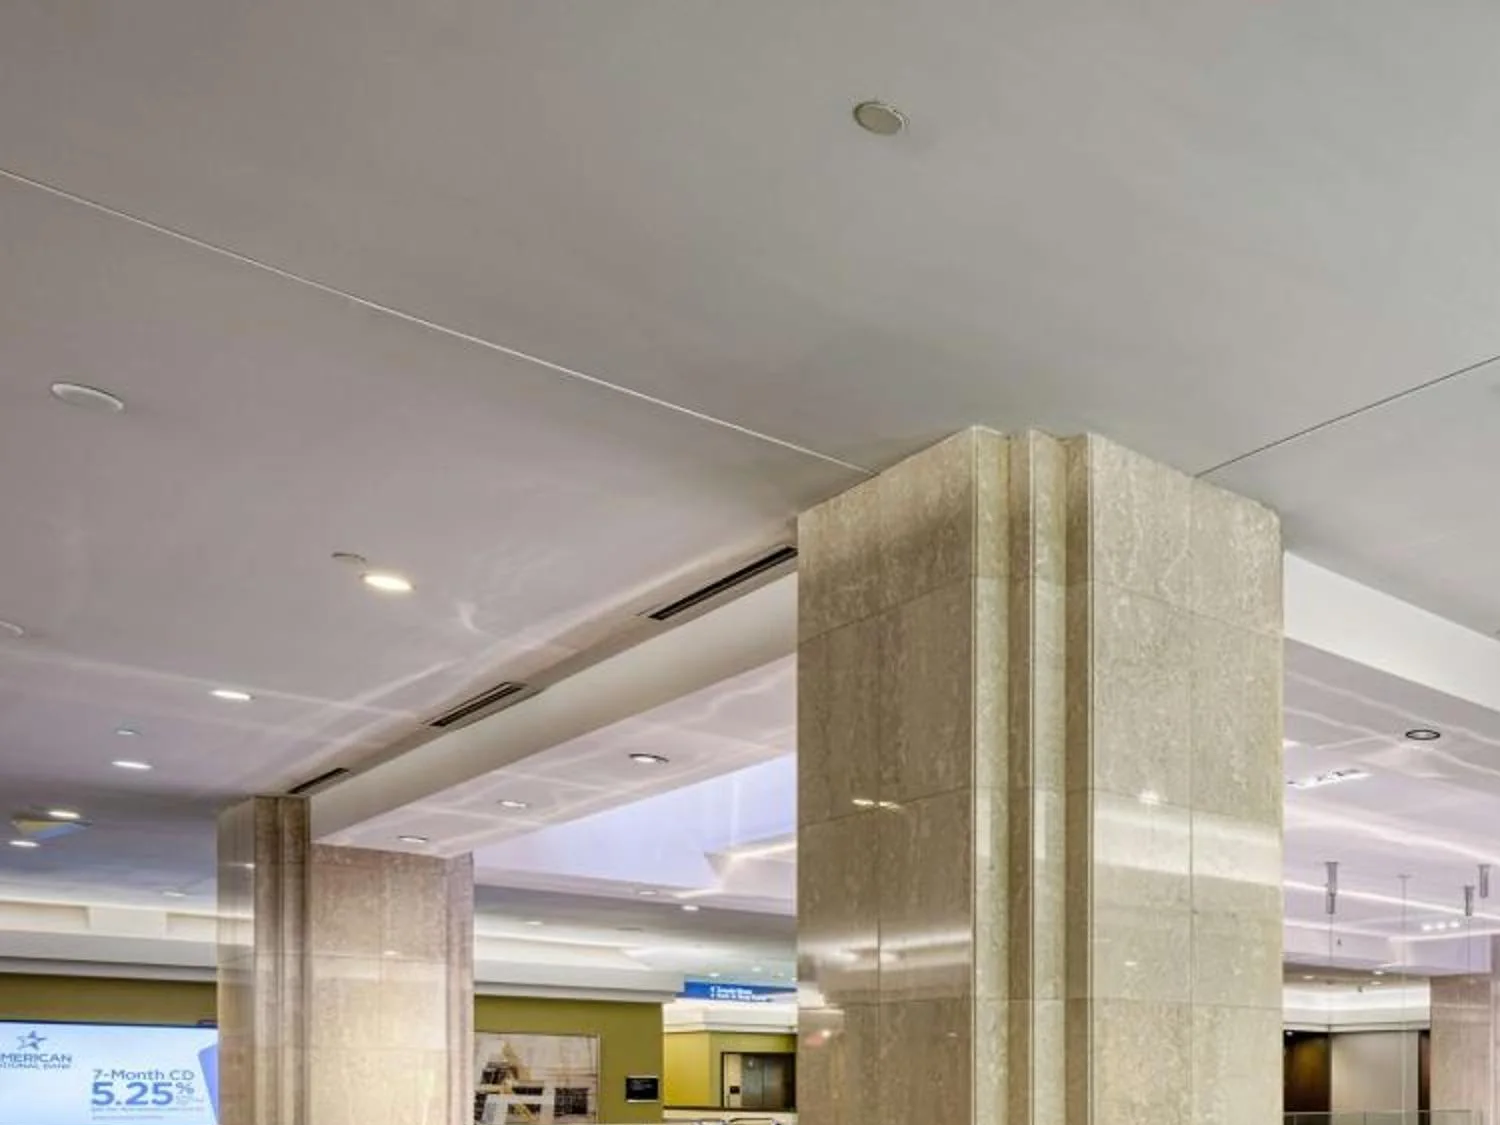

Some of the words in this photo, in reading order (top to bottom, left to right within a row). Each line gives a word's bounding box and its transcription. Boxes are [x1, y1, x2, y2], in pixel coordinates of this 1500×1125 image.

[0, 1053, 72, 1063] MERICAN
[93, 1069, 165, 1081] 7-Month
[169, 1070, 195, 1081] CD
[91, 1082, 173, 1106] 5.25
